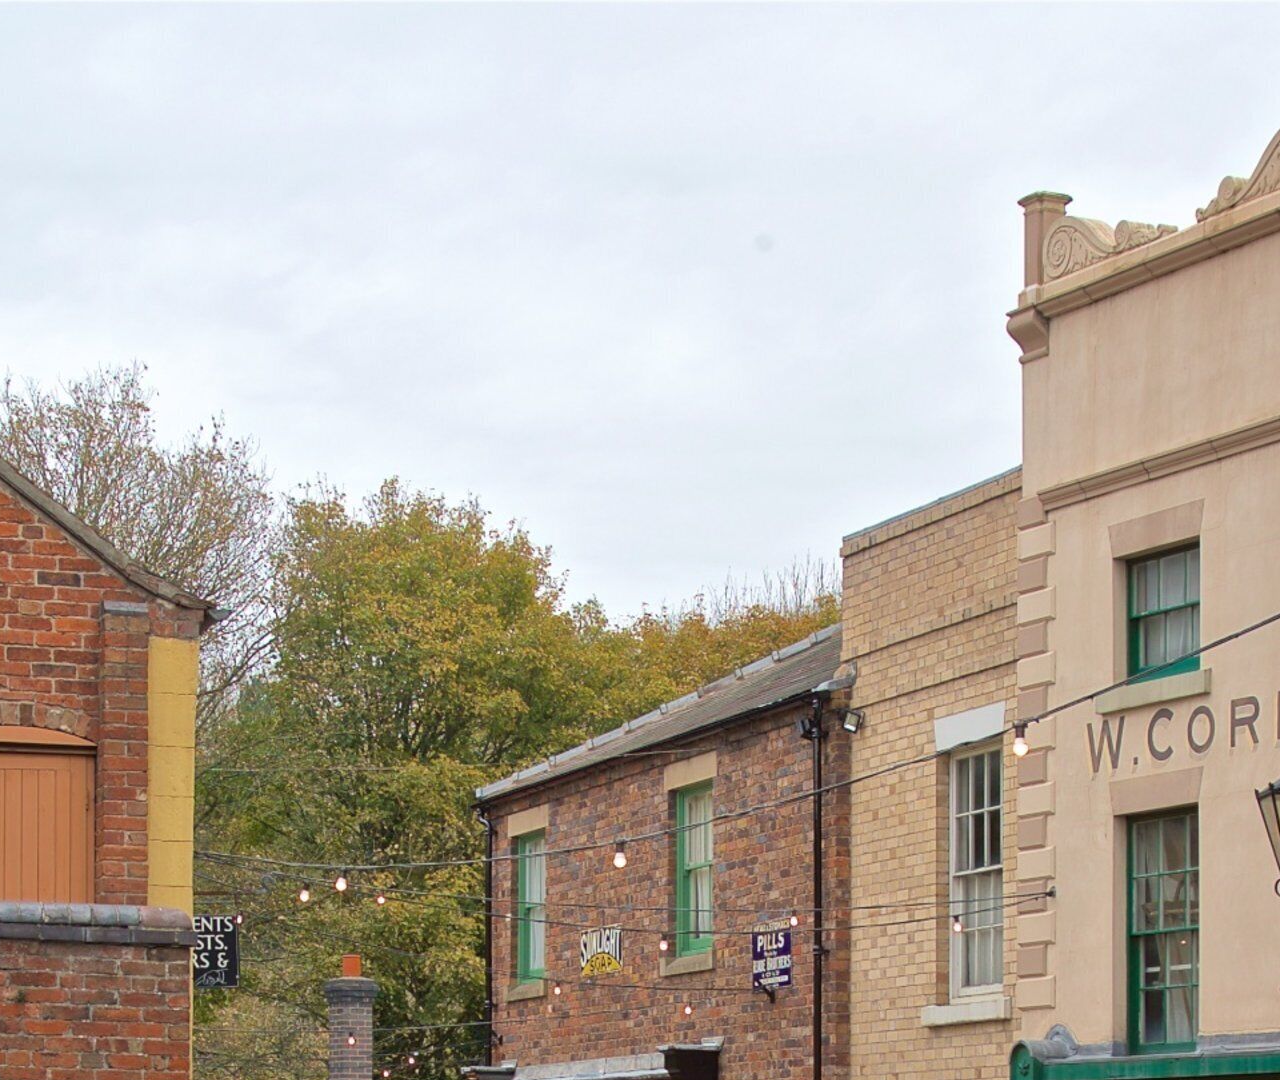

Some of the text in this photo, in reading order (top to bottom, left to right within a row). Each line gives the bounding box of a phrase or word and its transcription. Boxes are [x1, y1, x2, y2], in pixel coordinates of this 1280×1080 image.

[581, 928, 622, 967] SUNLIGHT
[757, 932, 784, 953] PILLS
[217, 952, 228, 968] &
